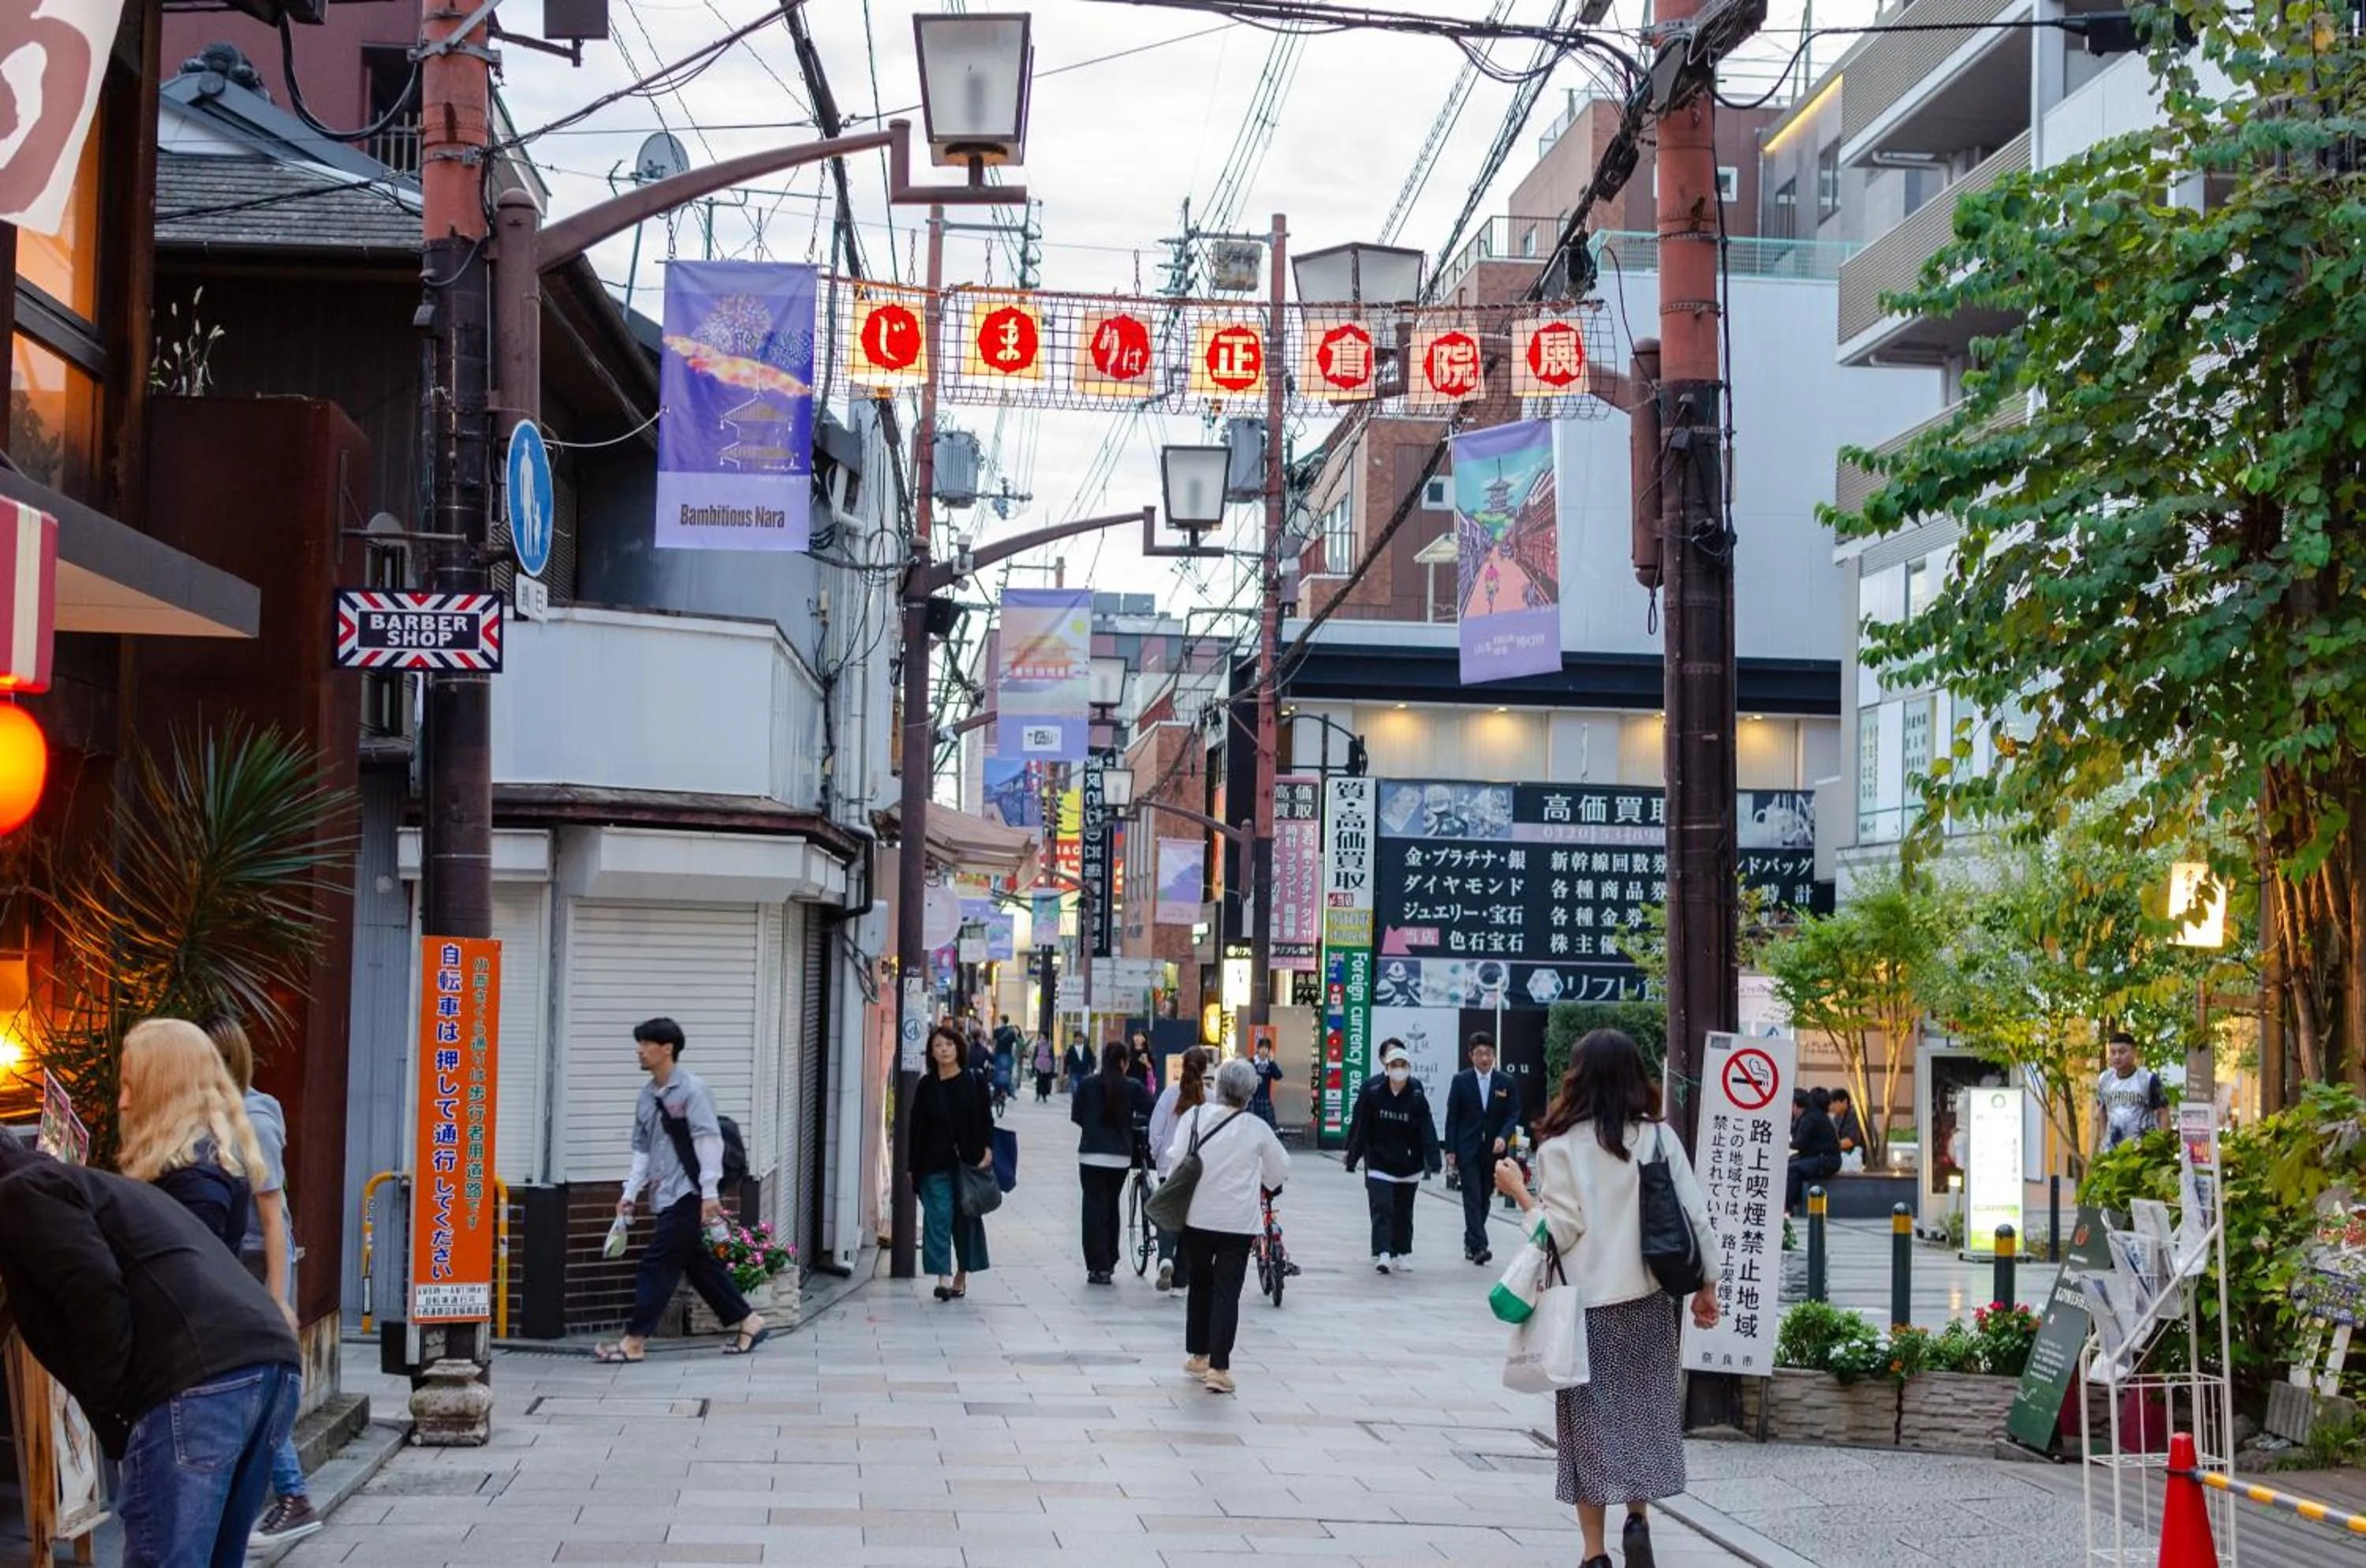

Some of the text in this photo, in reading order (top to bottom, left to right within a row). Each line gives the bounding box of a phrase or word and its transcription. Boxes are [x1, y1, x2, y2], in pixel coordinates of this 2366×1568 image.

[681, 503, 786, 528] Bambitious Nara
[370, 614, 468, 632] BARBER
[386, 630, 453, 647] SHOP
[1334, 780, 1366, 890] 質・高価買取
[1405, 846, 1526, 869] 金・プラチナ・銀
[1550, 851, 1666, 873] 新幹線回数券
[1404, 874, 1524, 897] ダイヤモンド
[1551, 878, 1666, 901] 各種商品券
[1403, 902, 1524, 924] ジュエリー・宝石
[1551, 906, 1644, 928] 各種金券
[1449, 931, 1524, 953] 色石宝石
[1347, 952, 1368, 1001] Foreign
[1345, 1006, 1364, 1066] currency
[432, 943, 462, 1279] 自転車は押して通行してください
[1706, 1114, 1728, 1237] 禁止されていま
[1733, 1119, 1772, 1338] 路上喫煙禁止地域
[1701, 1352, 1754, 1367] 奈良市
